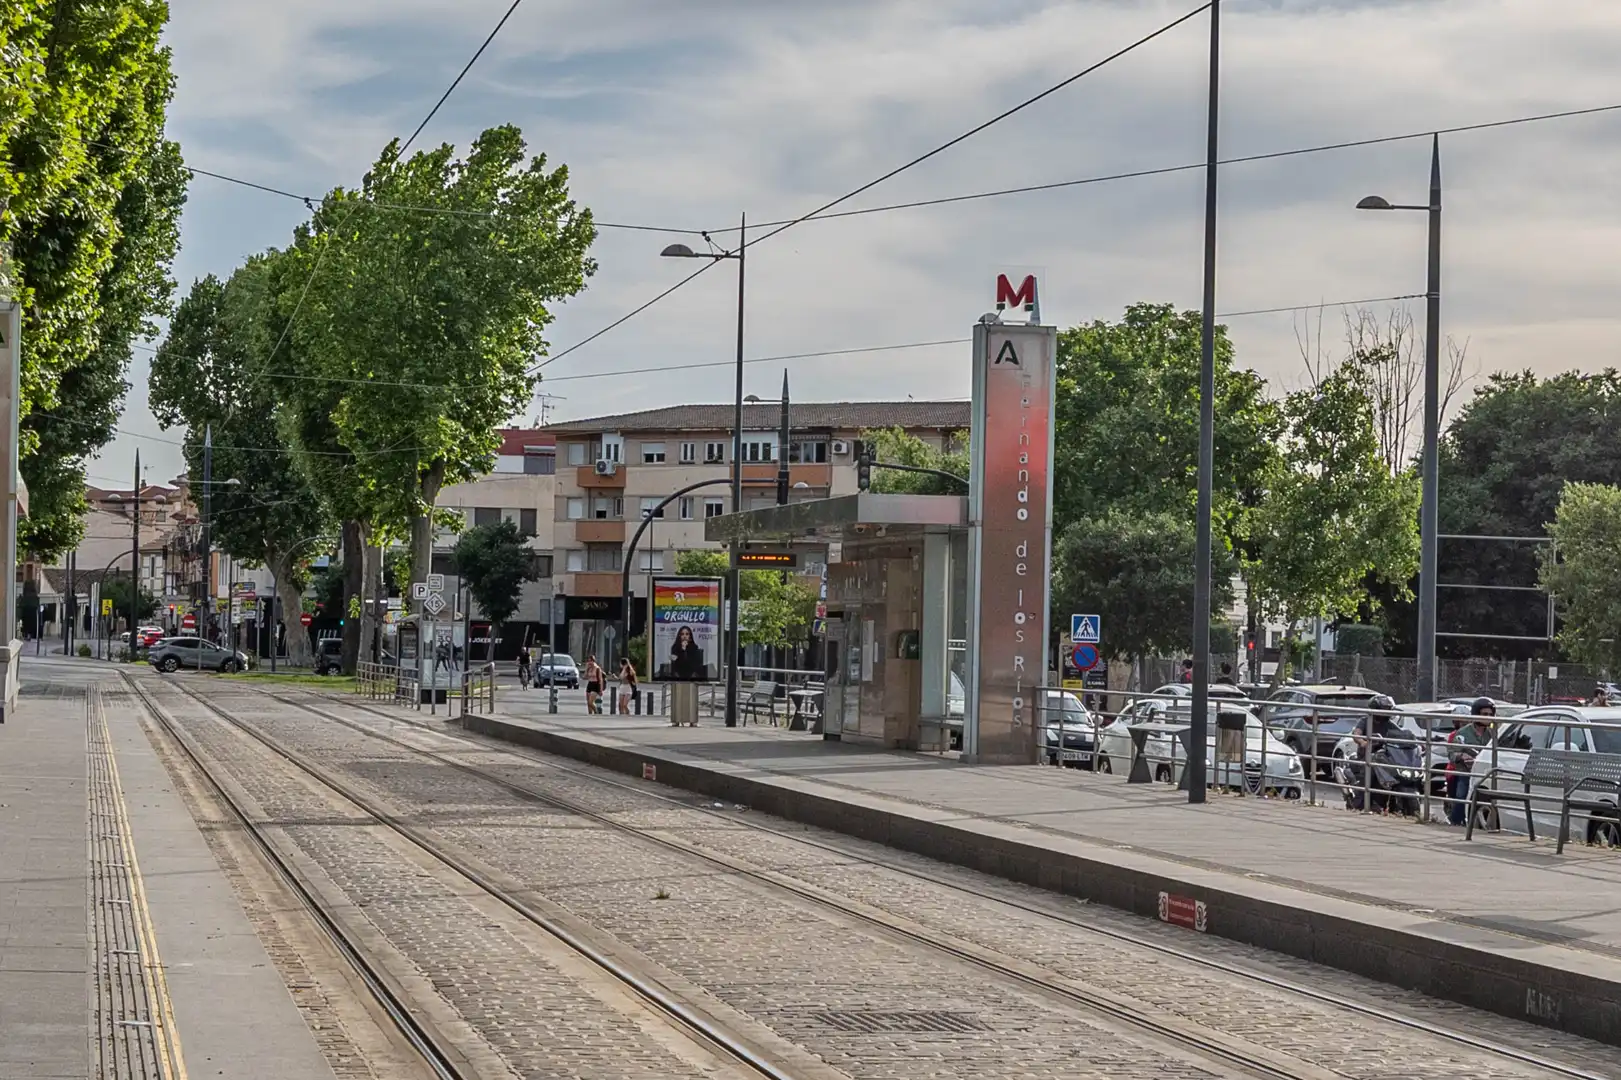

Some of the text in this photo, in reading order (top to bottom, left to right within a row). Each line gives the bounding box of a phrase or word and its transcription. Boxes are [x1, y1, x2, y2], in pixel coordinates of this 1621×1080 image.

[996, 273, 1035, 311] M
[1015, 540, 1027, 576] de
[418, 587, 425, 595] P
[664, 610, 705, 622] ORGULLO
[1014, 588, 1026, 643] los
[1013, 655, 1025, 728] Ríos
